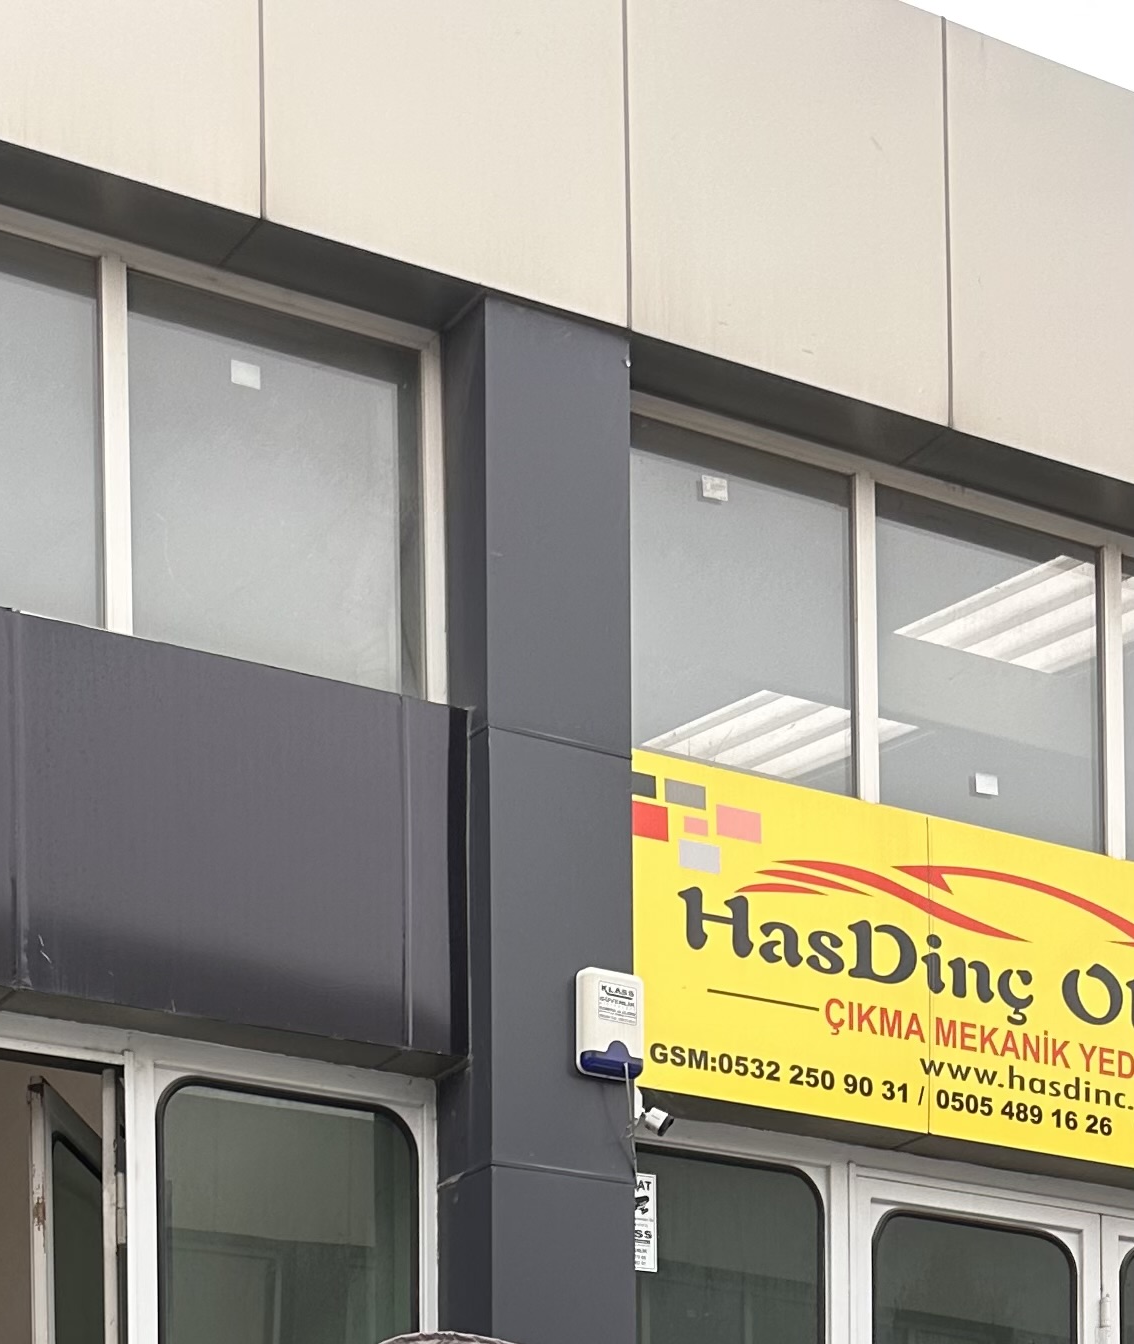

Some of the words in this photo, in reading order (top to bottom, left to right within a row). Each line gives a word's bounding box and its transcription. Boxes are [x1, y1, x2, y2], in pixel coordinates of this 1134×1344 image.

[677, 886, 1033, 1025] HasDinç
[1061, 963, 1134, 1029] O
[824, 998, 926, 1044] ÇIKMA
[935, 1016, 1072, 1069] MEKANİK
[649, 1042, 781, 1082] GSM:0532
[789, 1063, 835, 1091] 250
[843, 1073, 874, 1097] 90
[882, 1079, 909, 1104] 31
[917, 1085, 926, 1106] /
[936, 1088, 994, 1117] 0505
[1000, 1100, 1044, 1125] 489
[1051, 1107, 1079, 1131] 16
[1085, 1114, 1113, 1136] 26
